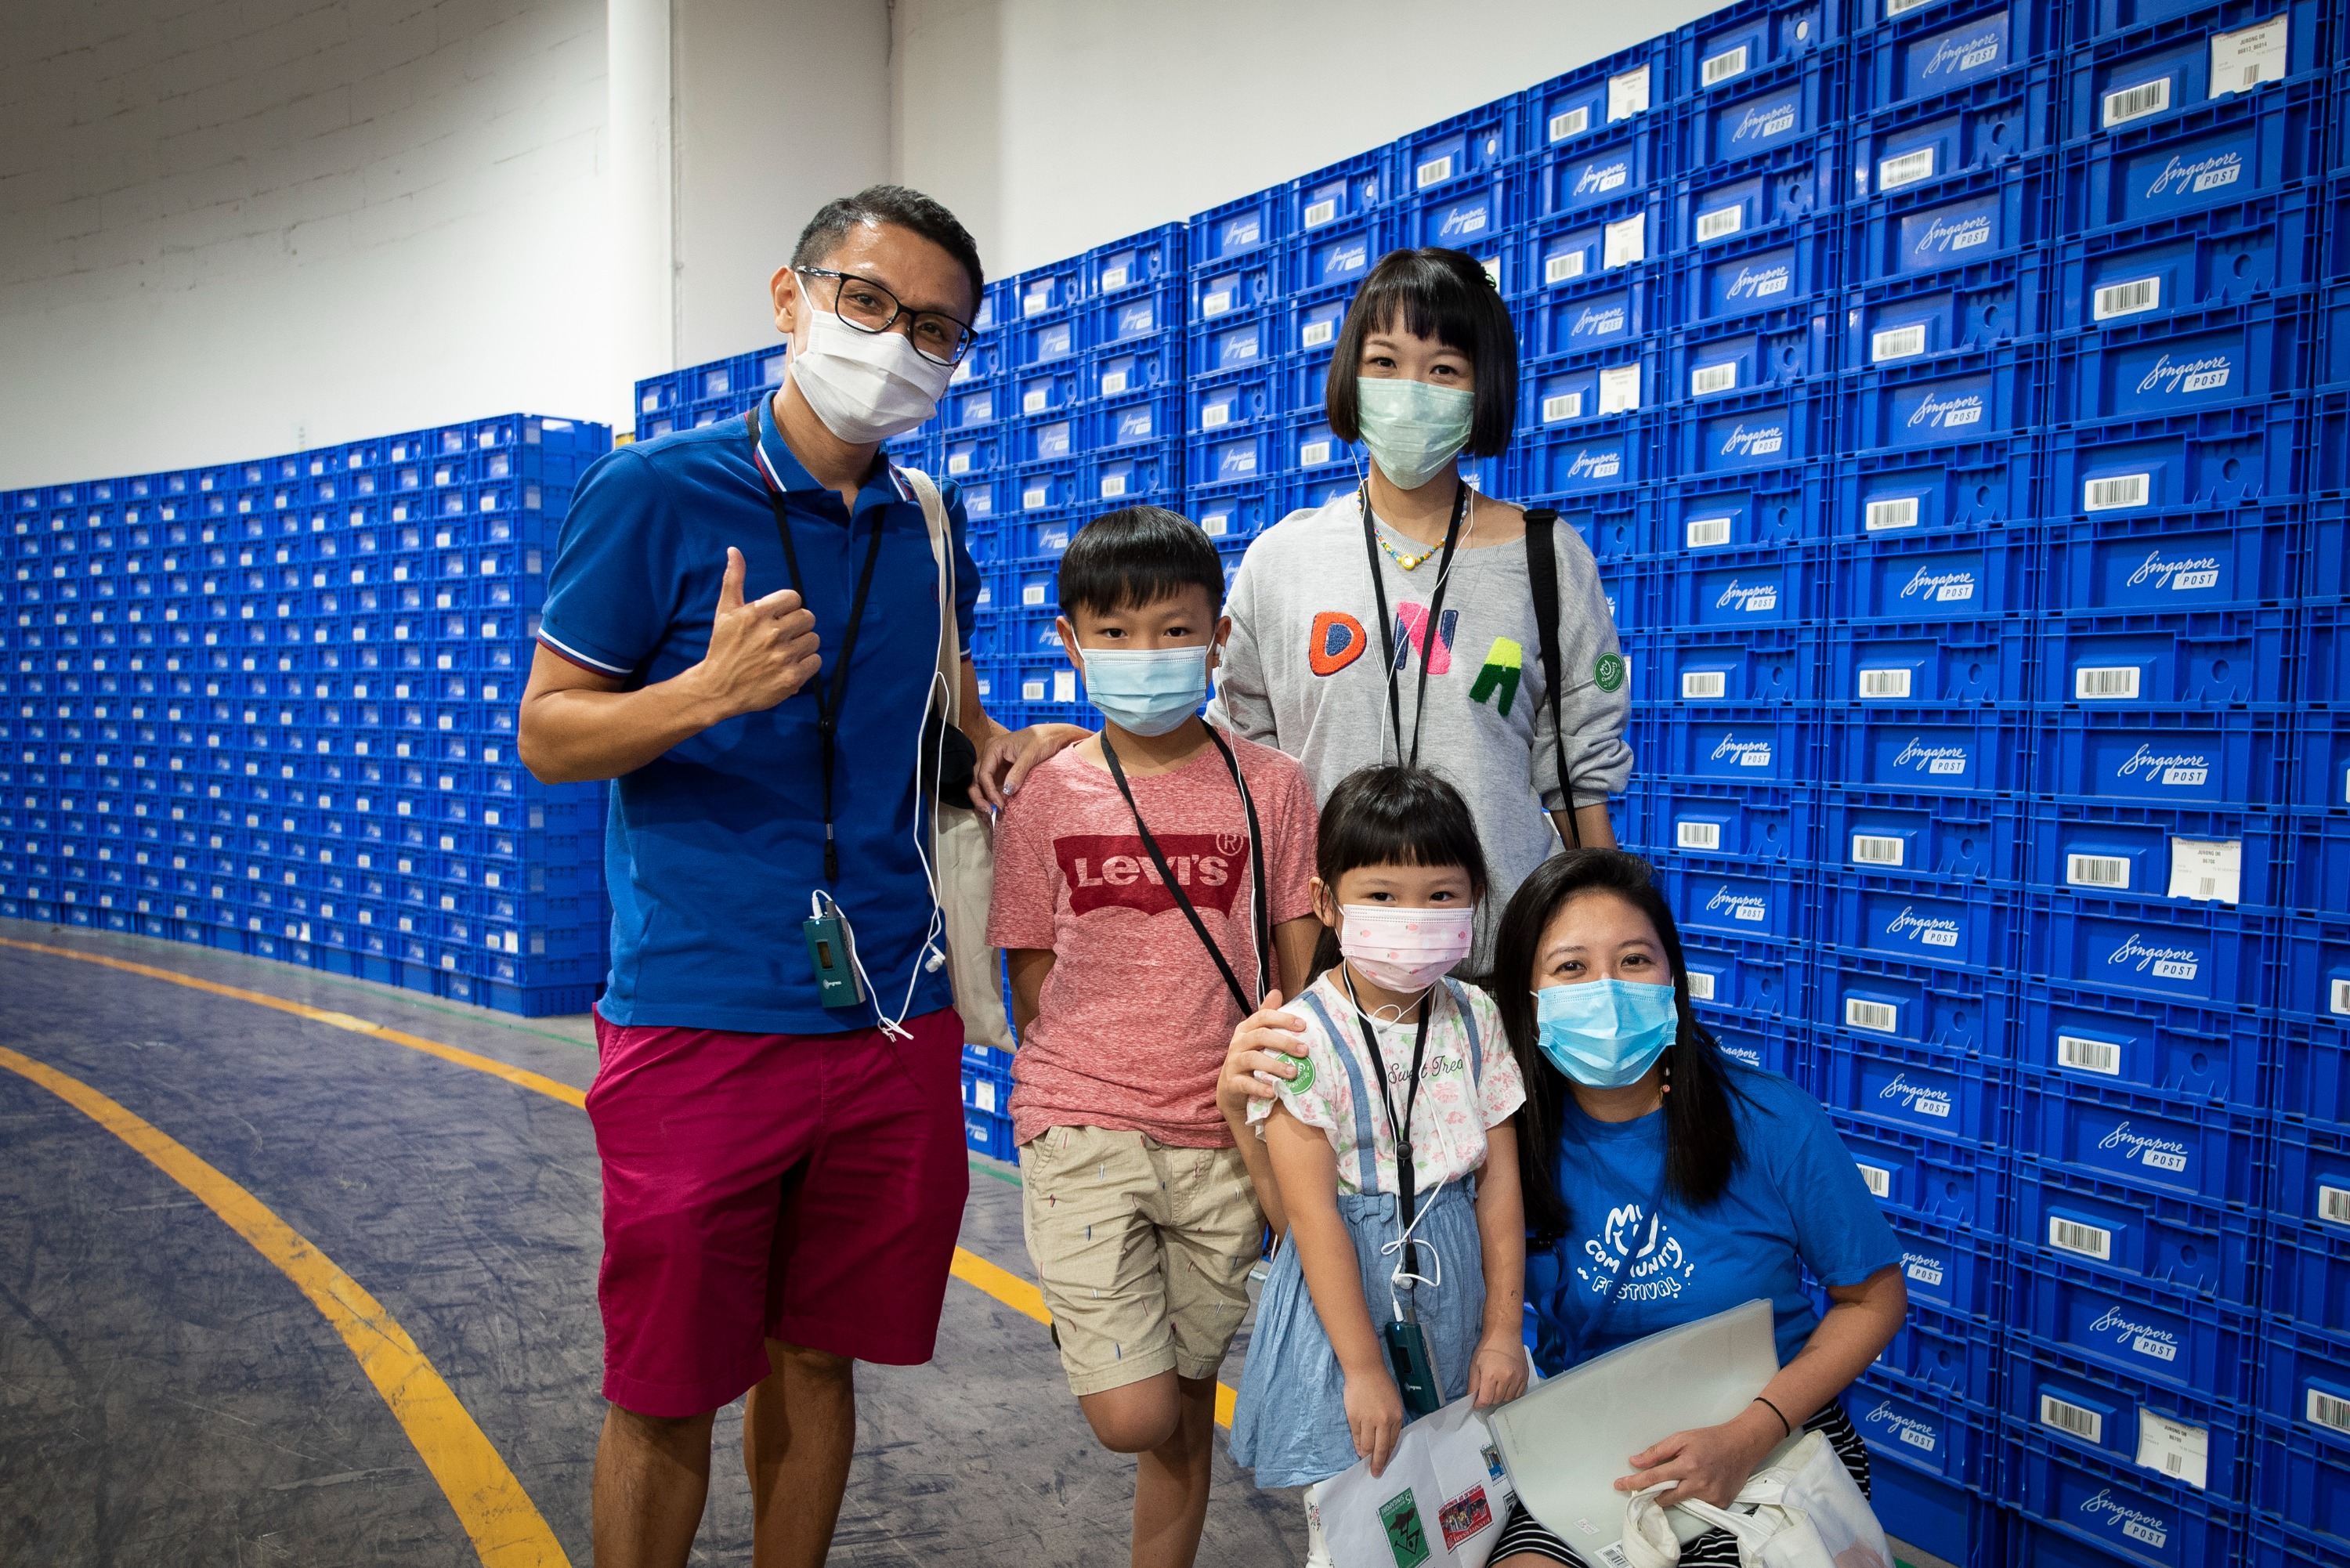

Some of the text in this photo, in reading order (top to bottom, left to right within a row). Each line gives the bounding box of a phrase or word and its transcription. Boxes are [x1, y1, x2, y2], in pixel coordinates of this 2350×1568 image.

[2240, 34, 2258, 45] JURONG
[1922, 34, 1999, 78] Singapore
[1969, 48, 1994, 64] POST
[1733, 104, 1793, 143] Singapore
[1768, 117, 1789, 132] POST
[1573, 163, 1627, 197] Singapore
[2145, 151, 2243, 198] Singapore
[2204, 167, 2236, 187] POST
[1915, 215, 1990, 254] Singapore
[1961, 229, 1985, 244] POST
[1726, 266, 1788, 299] Singapore
[1765, 280, 1784, 293] POST
[1571, 306, 1624, 337] Singapore
[2137, 354, 2231, 393] Singapore
[2193, 372, 2225, 388] POST
[1907, 392, 1983, 427] Singapore
[1952, 410, 1976, 424] POST
[1721, 424, 1783, 456] Singapore
[1759, 439, 1779, 451] POST
[1567, 450, 1620, 479] Singapore
[2126, 550, 2220, 589] Singapore
[1900, 565, 1974, 600] Singapore
[2182, 574, 2214, 587] POST
[1716, 579, 1777, 610] Singapore
[1945, 586, 1970, 597] POST
[1752, 598, 1773, 609] POST
[1711, 733, 1772, 764] Singapore
[1747, 754, 1767, 764] POST
[1893, 736, 1967, 771] Singapore
[1937, 762, 1962, 771] POST
[2117, 743, 2210, 782] Singapore
[2172, 771, 2204, 782] POST
[1705, 885, 1766, 916] Singapore
[1741, 909, 1762, 919] POST
[1886, 905, 1960, 940] Singapore
[1929, 932, 1954, 944] POST
[2108, 933, 2199, 971] Singapore
[2161, 962, 2193, 977] POST
[1388, 1054, 1463, 1084] Swet Trea
[1880, 1073, 1951, 1106] Singapore
[1922, 1102, 1947, 1114] POST
[2098, 1121, 2188, 1158] Singapore
[2151, 1153, 2182, 1169] POST
[1900, 1252, 1943, 1270] gapore
[1914, 1268, 1939, 1282] POST
[2089, 1306, 2178, 1345] Singapore
[2142, 1341, 2173, 1359] POST
[1866, 1400, 1936, 1437] Singapore
[2164, 1425, 2181, 1435] JURONG
[1907, 1433, 1932, 1449] POST
[1380, 1495, 1405, 1515] SINGAPORE
[2081, 1488, 2167, 1531] Singapore
[2132, 1524, 2162, 1545] POST
